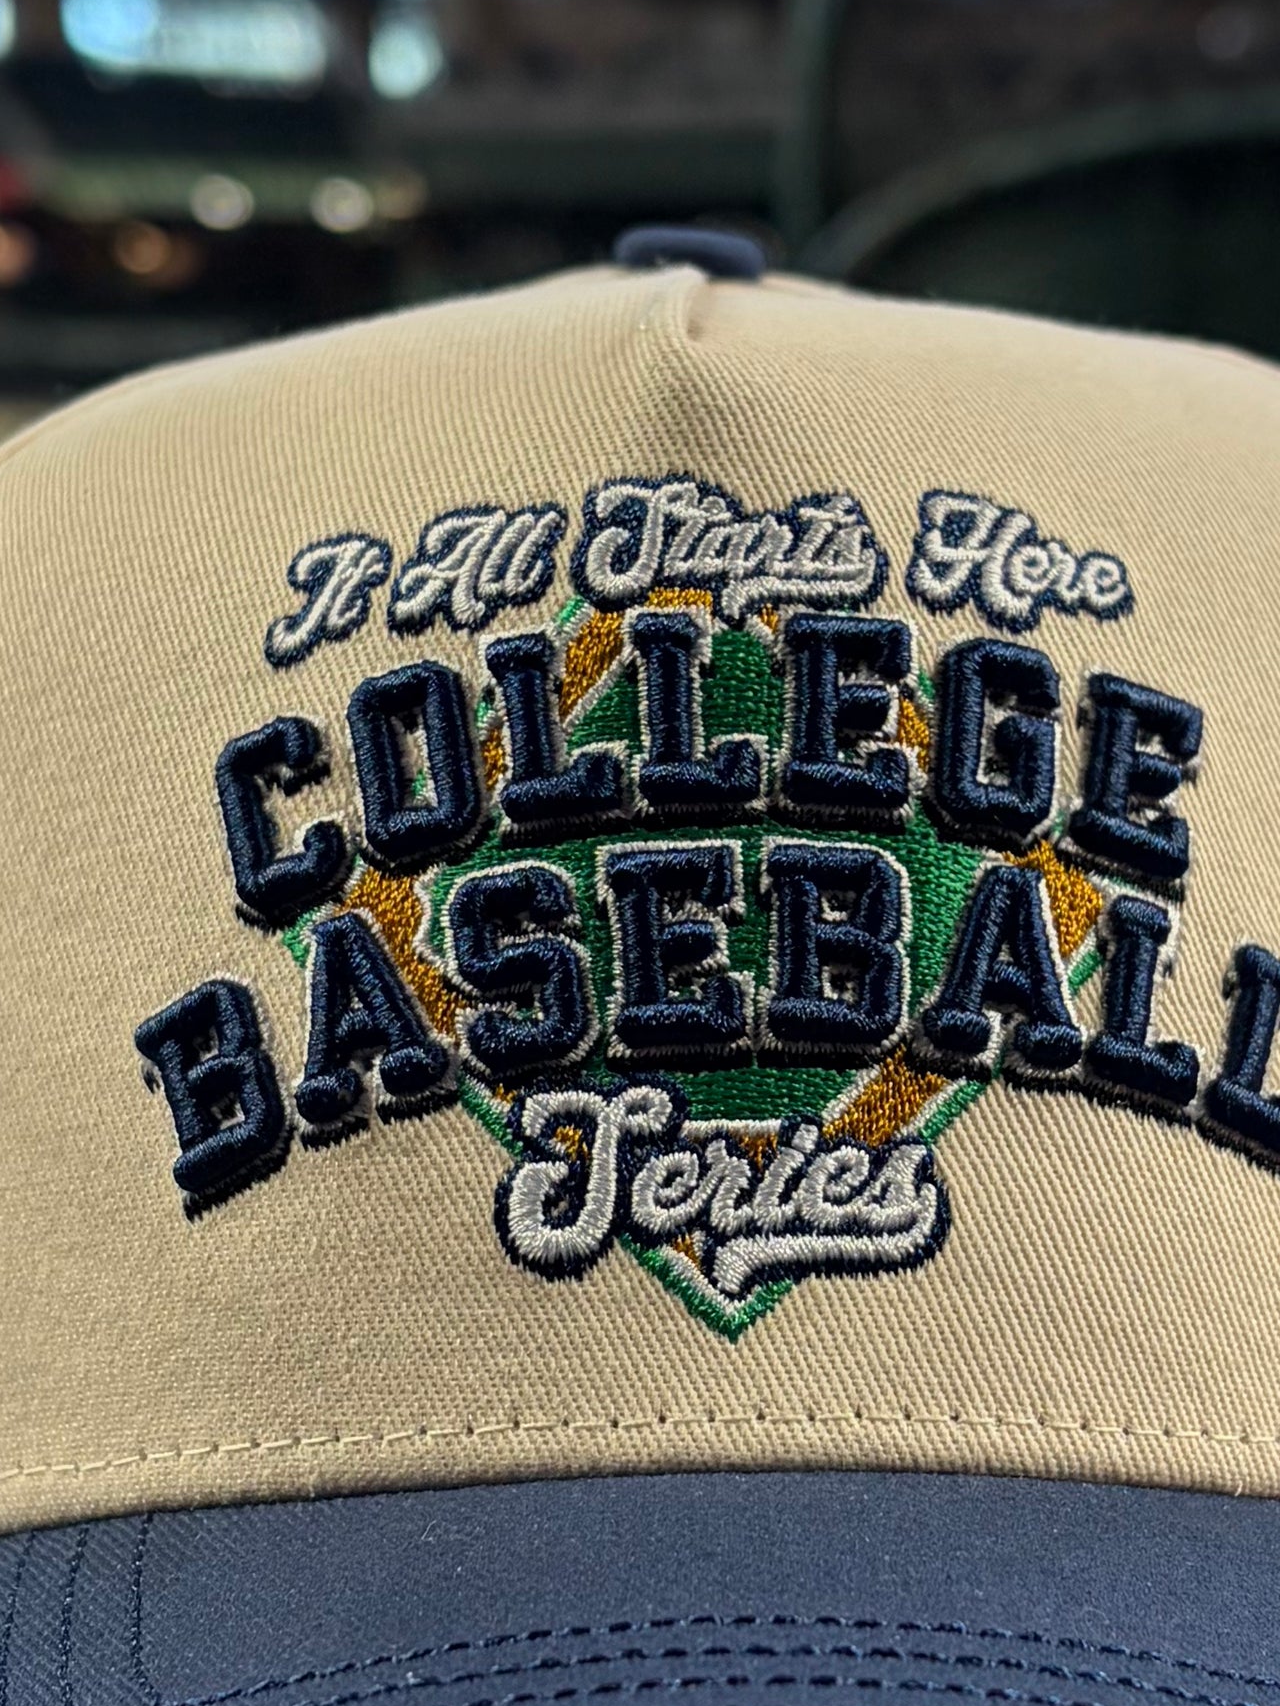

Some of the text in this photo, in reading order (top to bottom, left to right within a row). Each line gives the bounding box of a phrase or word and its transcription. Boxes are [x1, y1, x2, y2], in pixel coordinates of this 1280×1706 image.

[265, 473, 1134, 667] It All Starts Here
[214, 609, 1206, 925] COLLEGE
[494, 1078, 950, 1283] Series
